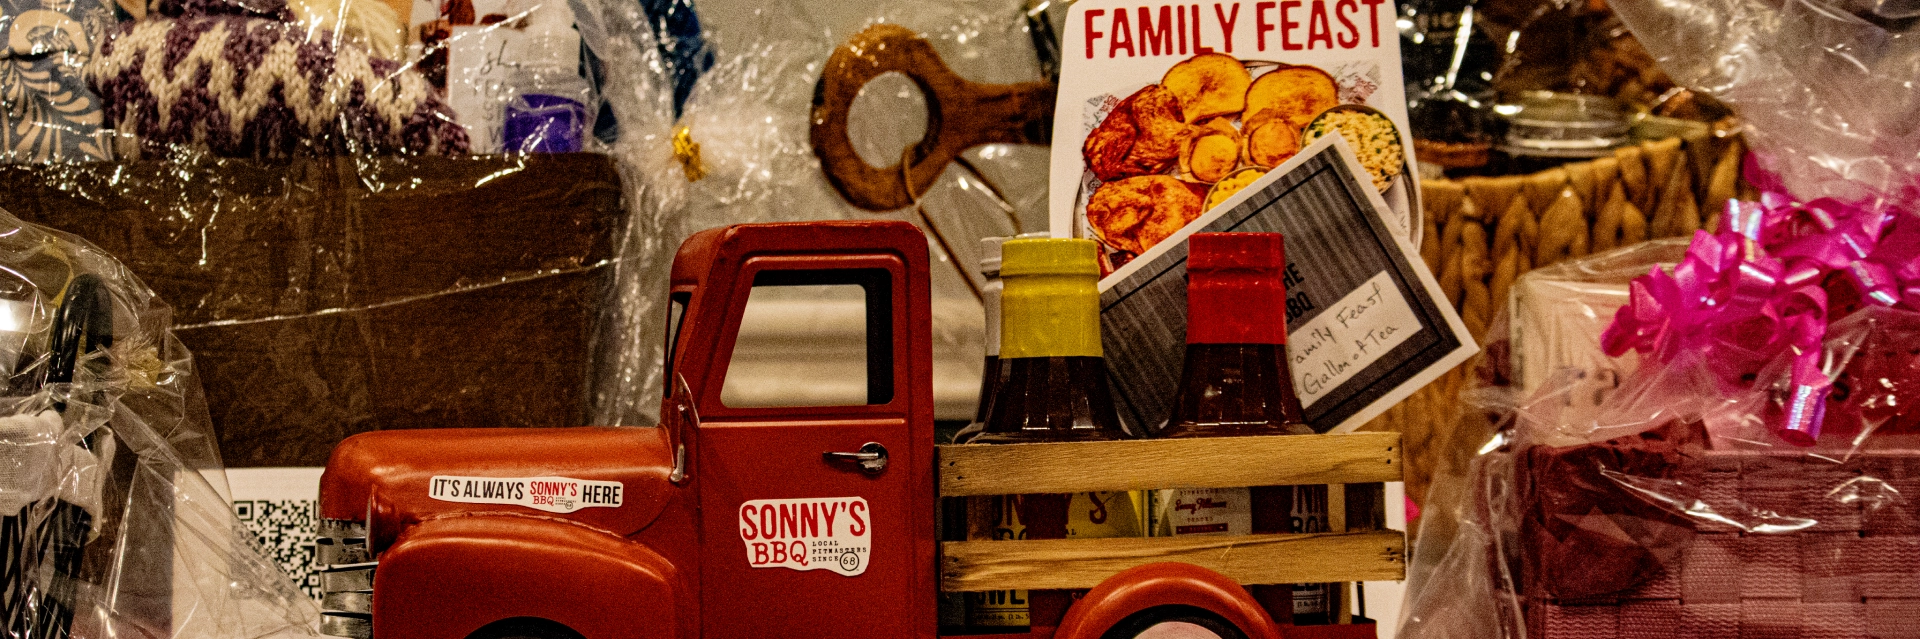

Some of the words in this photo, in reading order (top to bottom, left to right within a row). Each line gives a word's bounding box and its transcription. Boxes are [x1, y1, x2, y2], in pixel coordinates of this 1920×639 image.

[1085, 3, 1240, 59] FAMILY
[1257, 0, 1385, 51] FEAST
[1283, 262, 1304, 290] HE
[1290, 326, 1337, 365] amily
[1335, 282, 1384, 329] Feast
[1302, 359, 1351, 395] Gallon
[1353, 339, 1368, 361] of
[1364, 324, 1400, 346] Tea
[433, 479, 460, 497] IT'S
[463, 480, 524, 500] ALWAYS
[530, 481, 577, 496] SONNY'S
[582, 485, 621, 504] HERE
[533, 496, 554, 506] BBQ
[741, 501, 866, 540] SONNY'S
[751, 540, 809, 566] BBQ
[812, 547, 867, 555] PITMASTERS
[842, 557, 856, 566] 68
